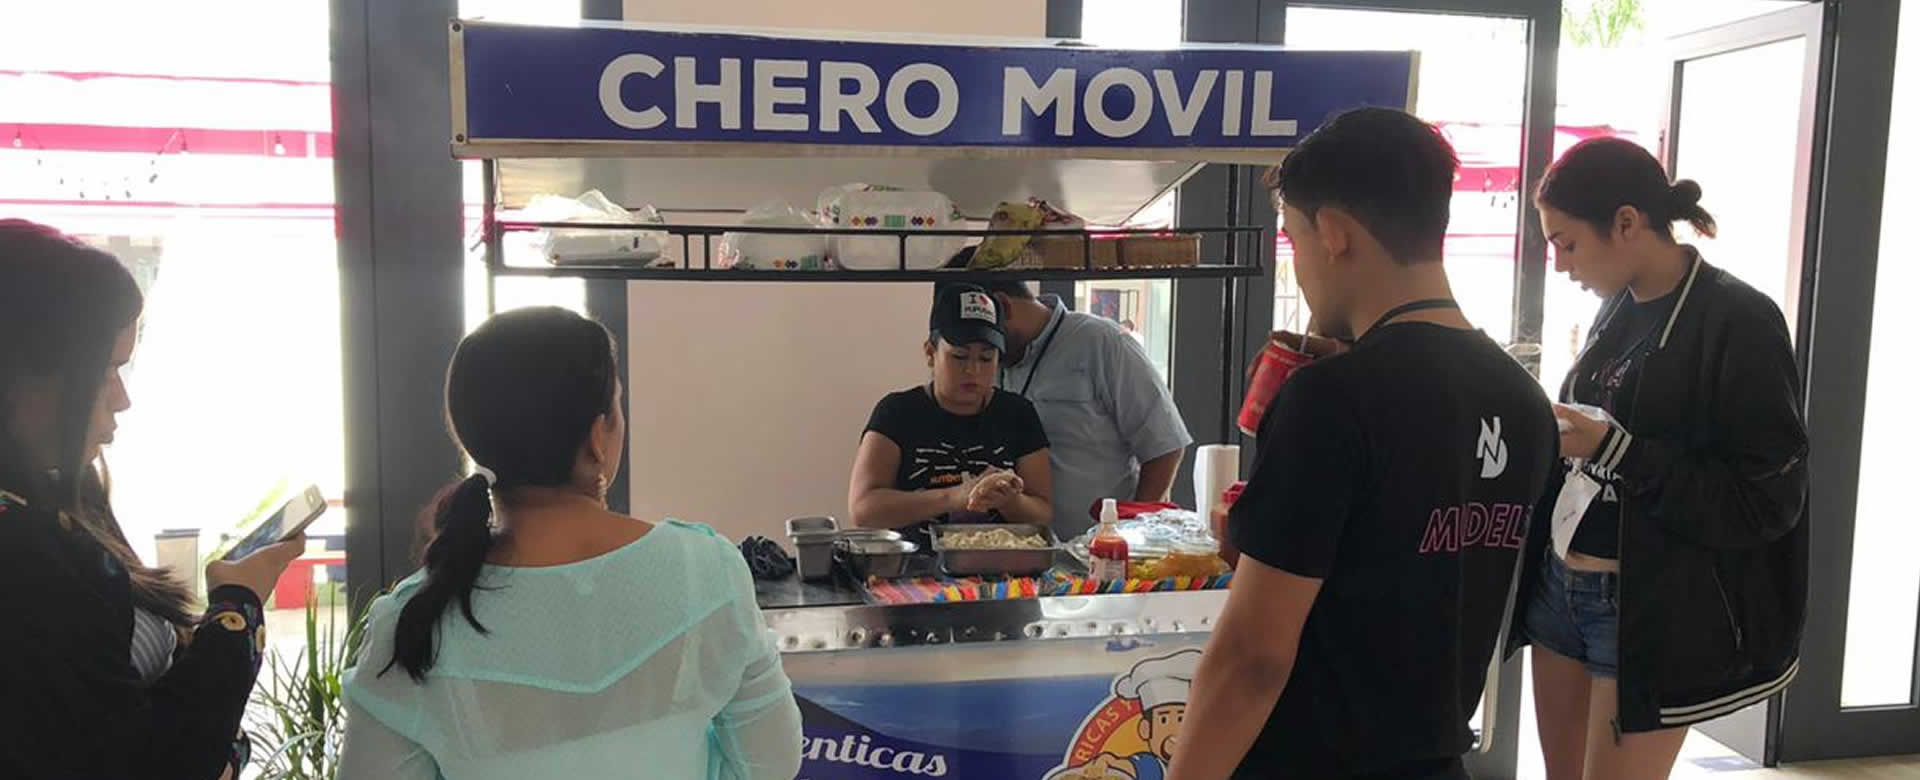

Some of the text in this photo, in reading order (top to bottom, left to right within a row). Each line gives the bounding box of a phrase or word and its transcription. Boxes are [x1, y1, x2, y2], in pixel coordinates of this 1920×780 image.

[599, 53, 1298, 137] CHERO MOVIL
[1075, 706, 1119, 761] RICAS
